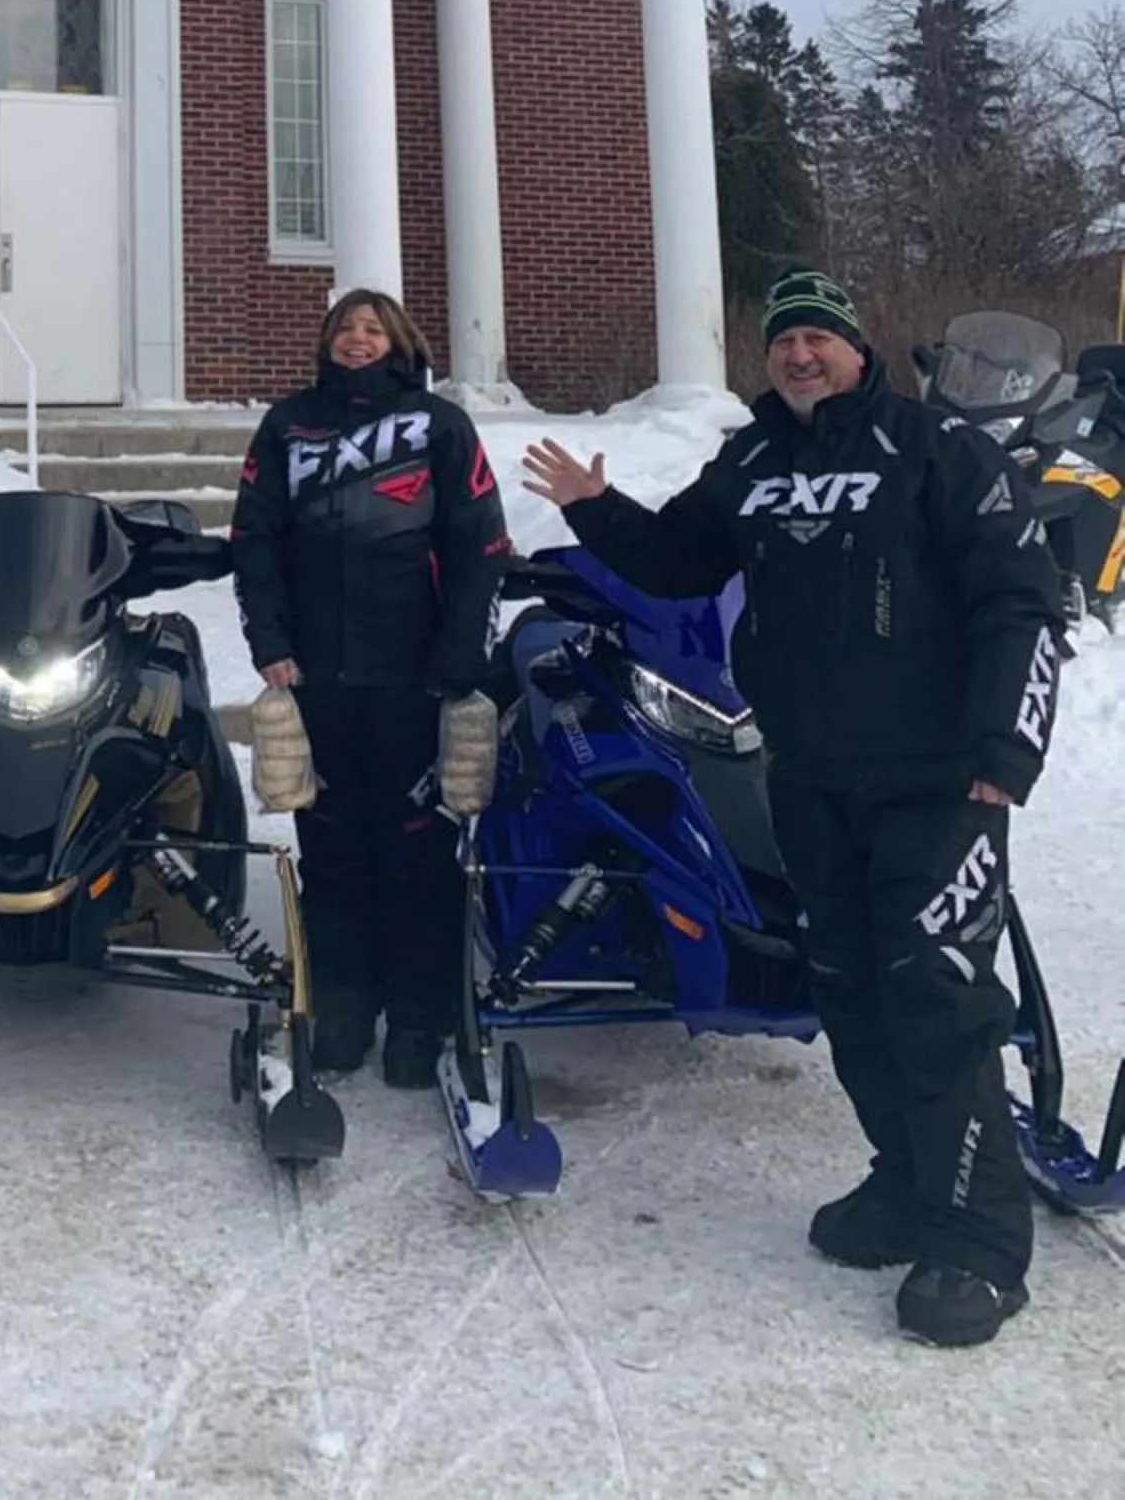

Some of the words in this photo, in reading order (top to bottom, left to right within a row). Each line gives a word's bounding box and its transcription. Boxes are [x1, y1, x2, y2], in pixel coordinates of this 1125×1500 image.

[287, 411, 432, 500] FXR
[738, 472, 882, 516] FXR
[1014, 625, 1055, 750] FXR
[913, 832, 997, 935] FXR
[963, 1116, 983, 1150] FX
[952, 1144, 975, 1209] TEAM
